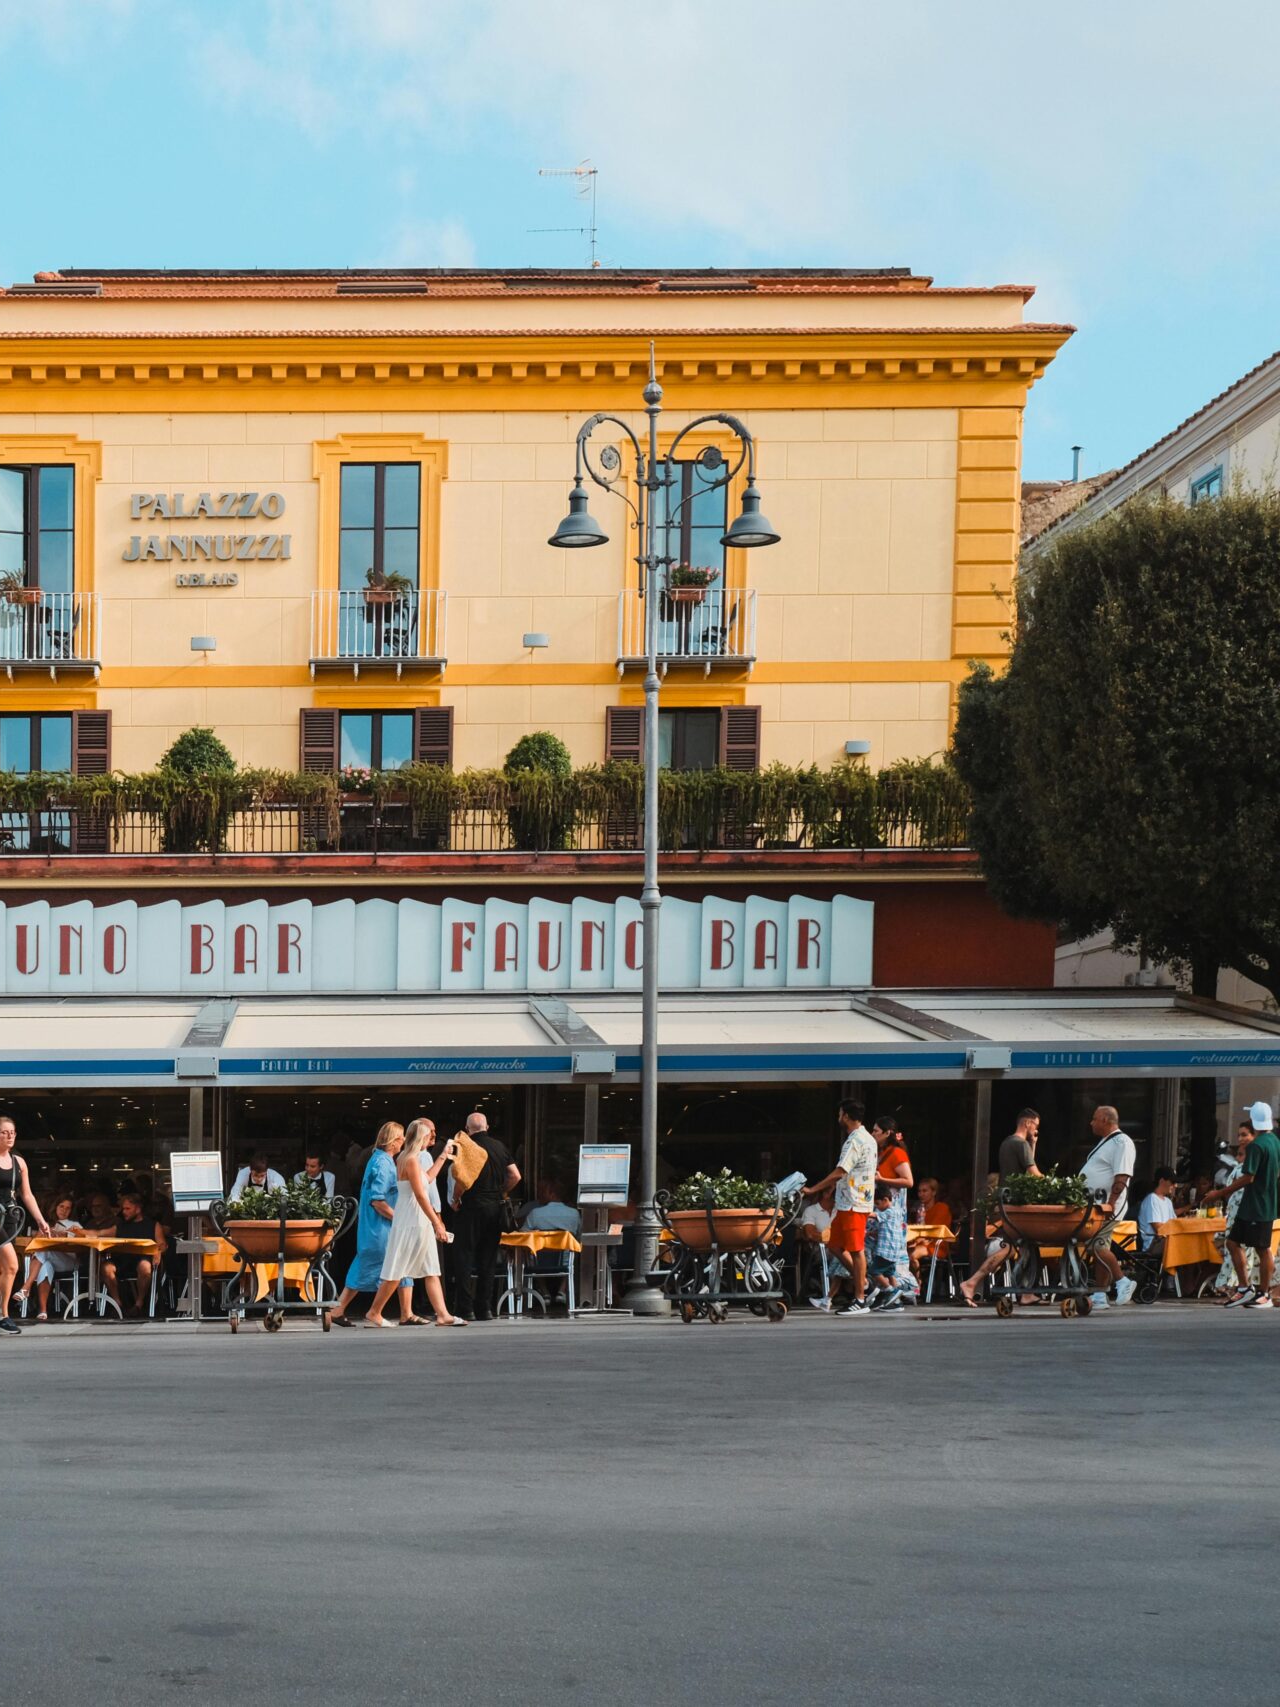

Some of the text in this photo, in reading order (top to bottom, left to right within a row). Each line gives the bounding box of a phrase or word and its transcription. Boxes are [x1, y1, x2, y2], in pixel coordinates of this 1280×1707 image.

[130, 492, 286, 519] PALAZZO
[122, 534, 292, 562] JANNUZZI
[175, 573, 239, 587] RELAIS
[190, 923, 302, 975] BAR
[451, 919, 821, 973] FAUNO BAR
[408, 1059, 526, 1070] restaurant snacks
